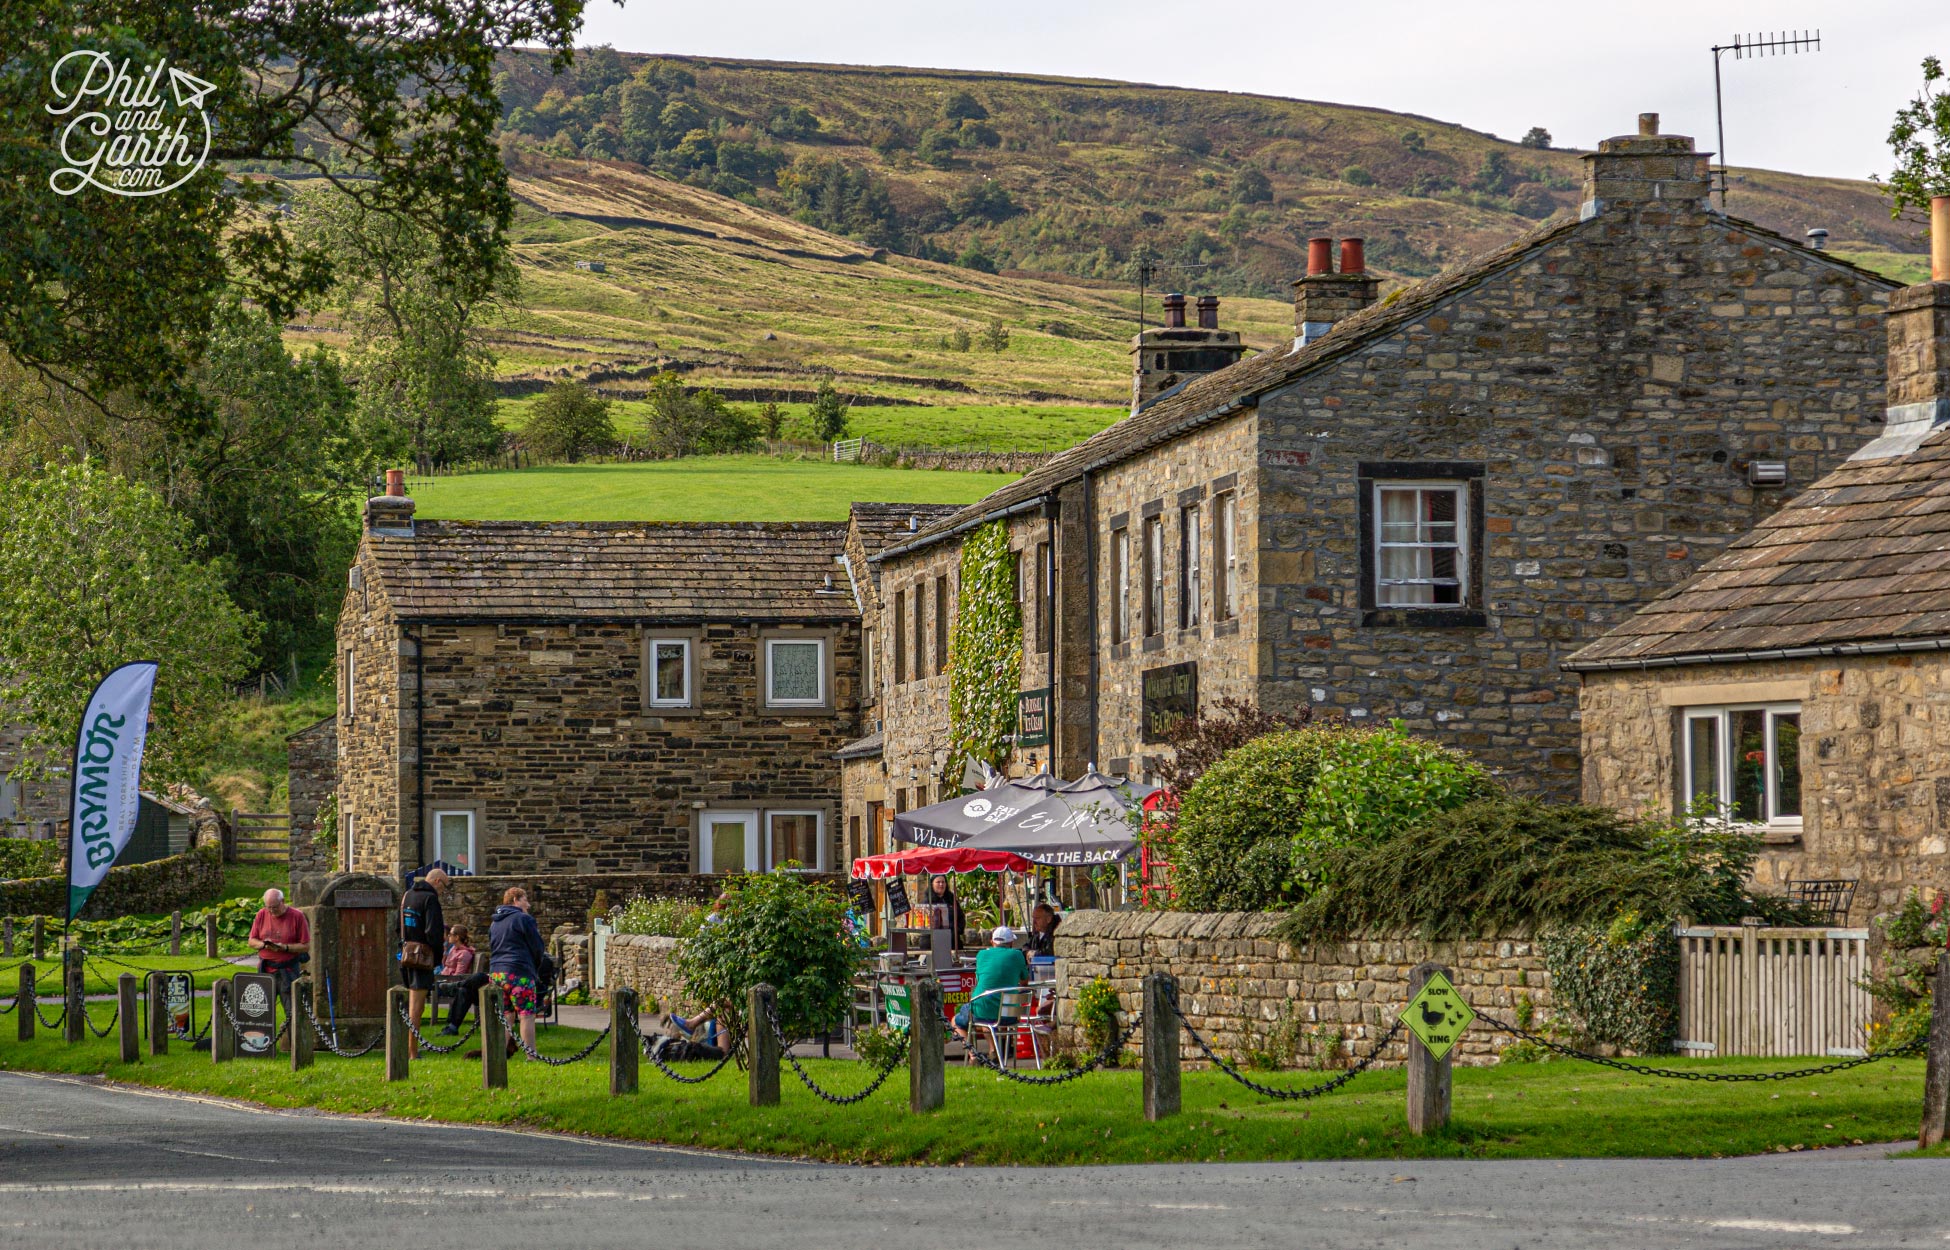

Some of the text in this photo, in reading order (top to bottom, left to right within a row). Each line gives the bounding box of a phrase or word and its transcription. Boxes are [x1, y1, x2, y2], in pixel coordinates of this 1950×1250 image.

[1150, 712, 1163, 734] TEA
[79, 711, 126, 871] BRYMOR
[1035, 853, 1055, 863] AT
[1055, 852, 1082, 863] THE
[1083, 849, 1121, 863] BACK
[943, 991, 969, 1004] URGERS
[1428, 988, 1449, 996] SLOW
[1428, 1035, 1450, 1044] XING
